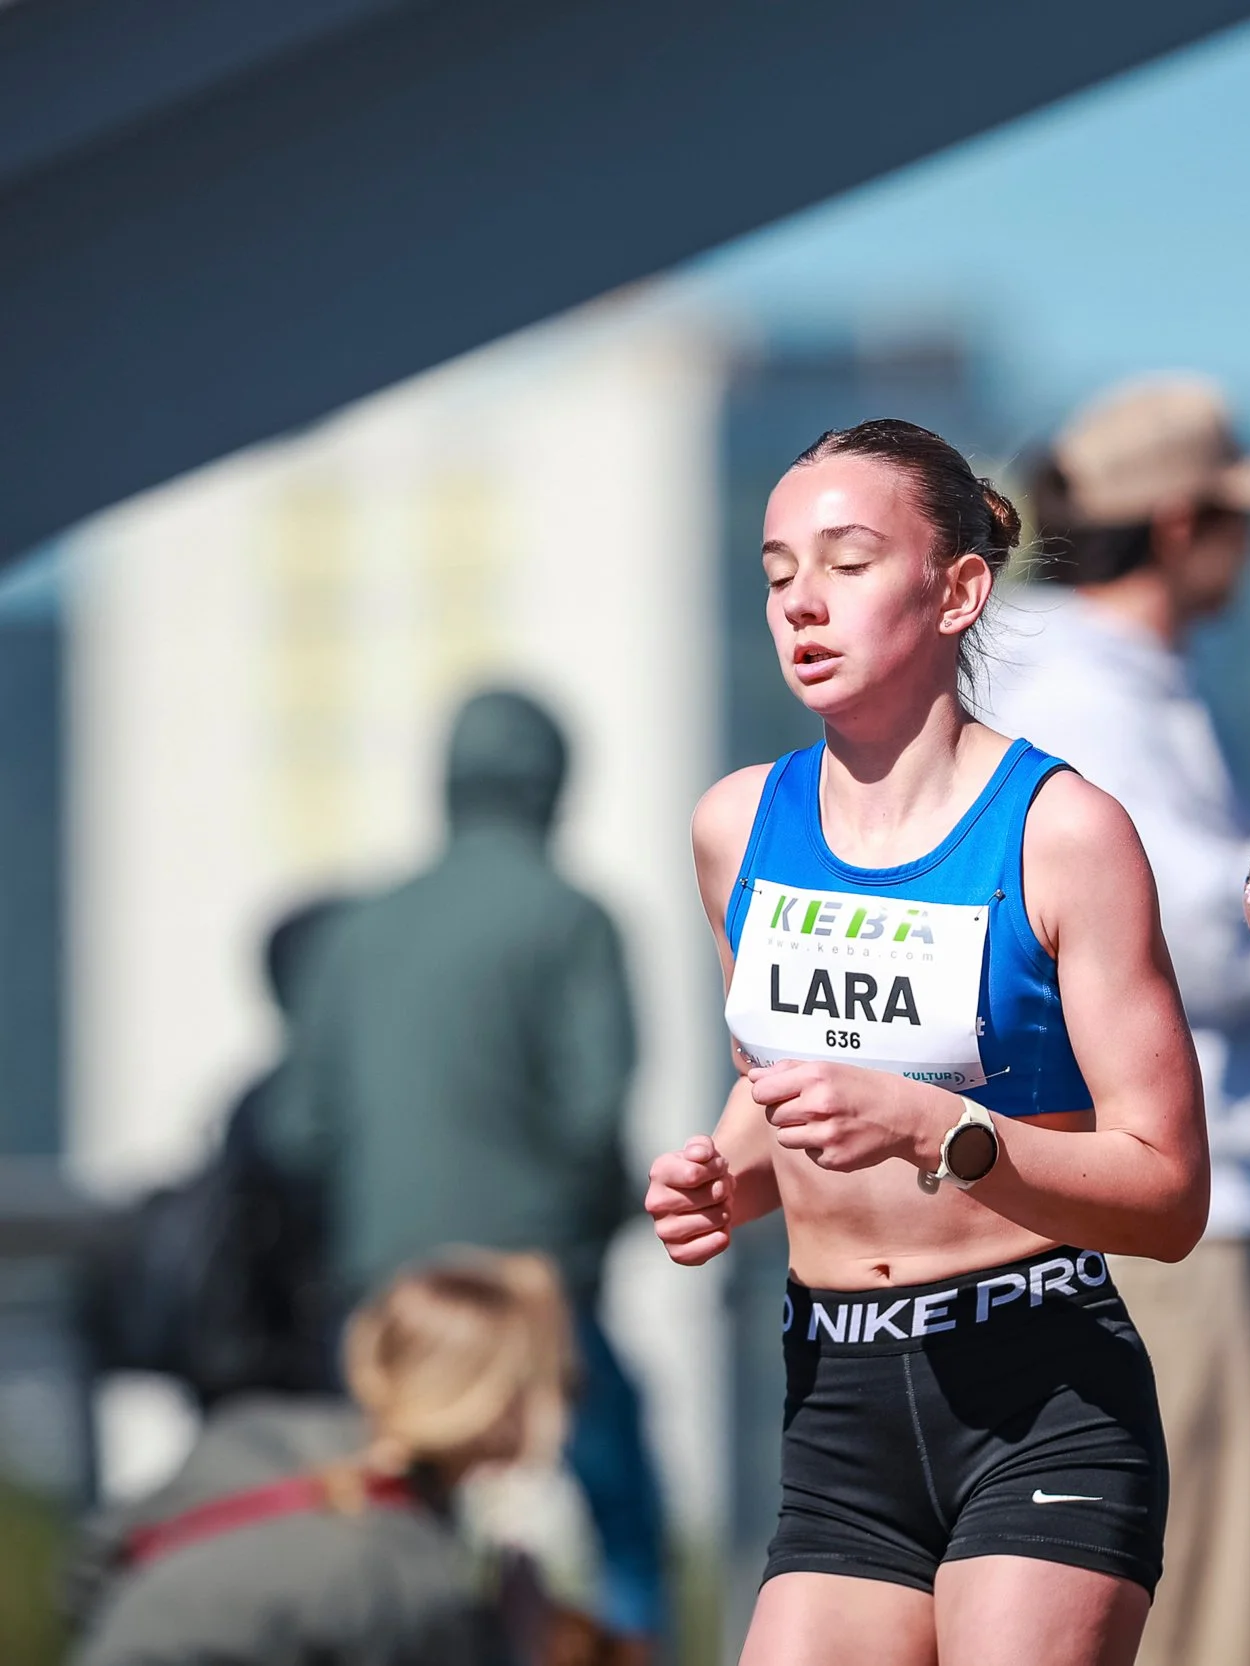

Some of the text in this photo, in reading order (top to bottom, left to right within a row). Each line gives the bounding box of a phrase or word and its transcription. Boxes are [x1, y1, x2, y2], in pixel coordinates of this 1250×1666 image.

[770, 895, 935, 945] KEBA
[771, 964, 921, 1026] LARA
[826, 1030, 861, 1049] 636
[903, 1072, 953, 1081] KULTUR
[807, 1288, 960, 1344] NIKE
[976, 1250, 1108, 1323] PRO
